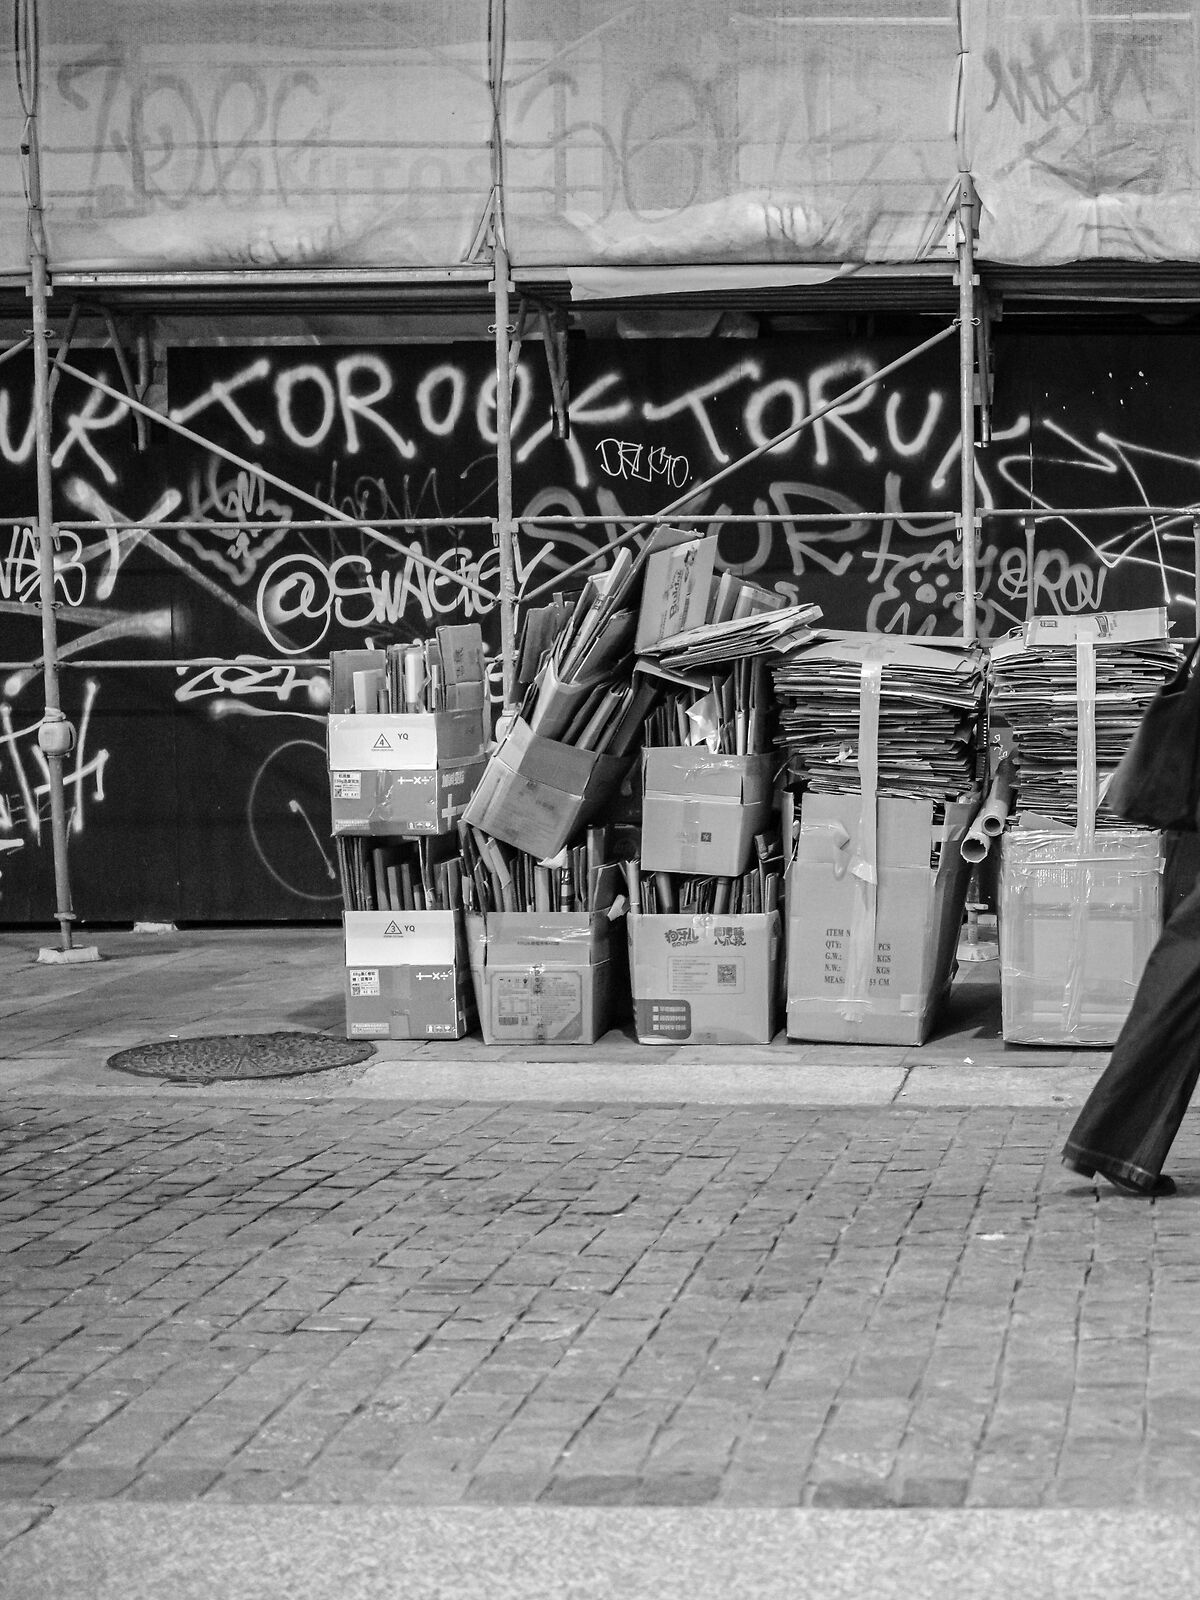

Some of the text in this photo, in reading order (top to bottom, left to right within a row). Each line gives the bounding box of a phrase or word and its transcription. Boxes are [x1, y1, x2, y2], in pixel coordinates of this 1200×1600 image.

[826, 928, 844, 937] ITEM
[825, 940, 891, 952] QTY: PCS
[877, 954, 891, 963] KGS
[876, 966, 890, 974] KGS
[878, 978, 890, 986] CM
